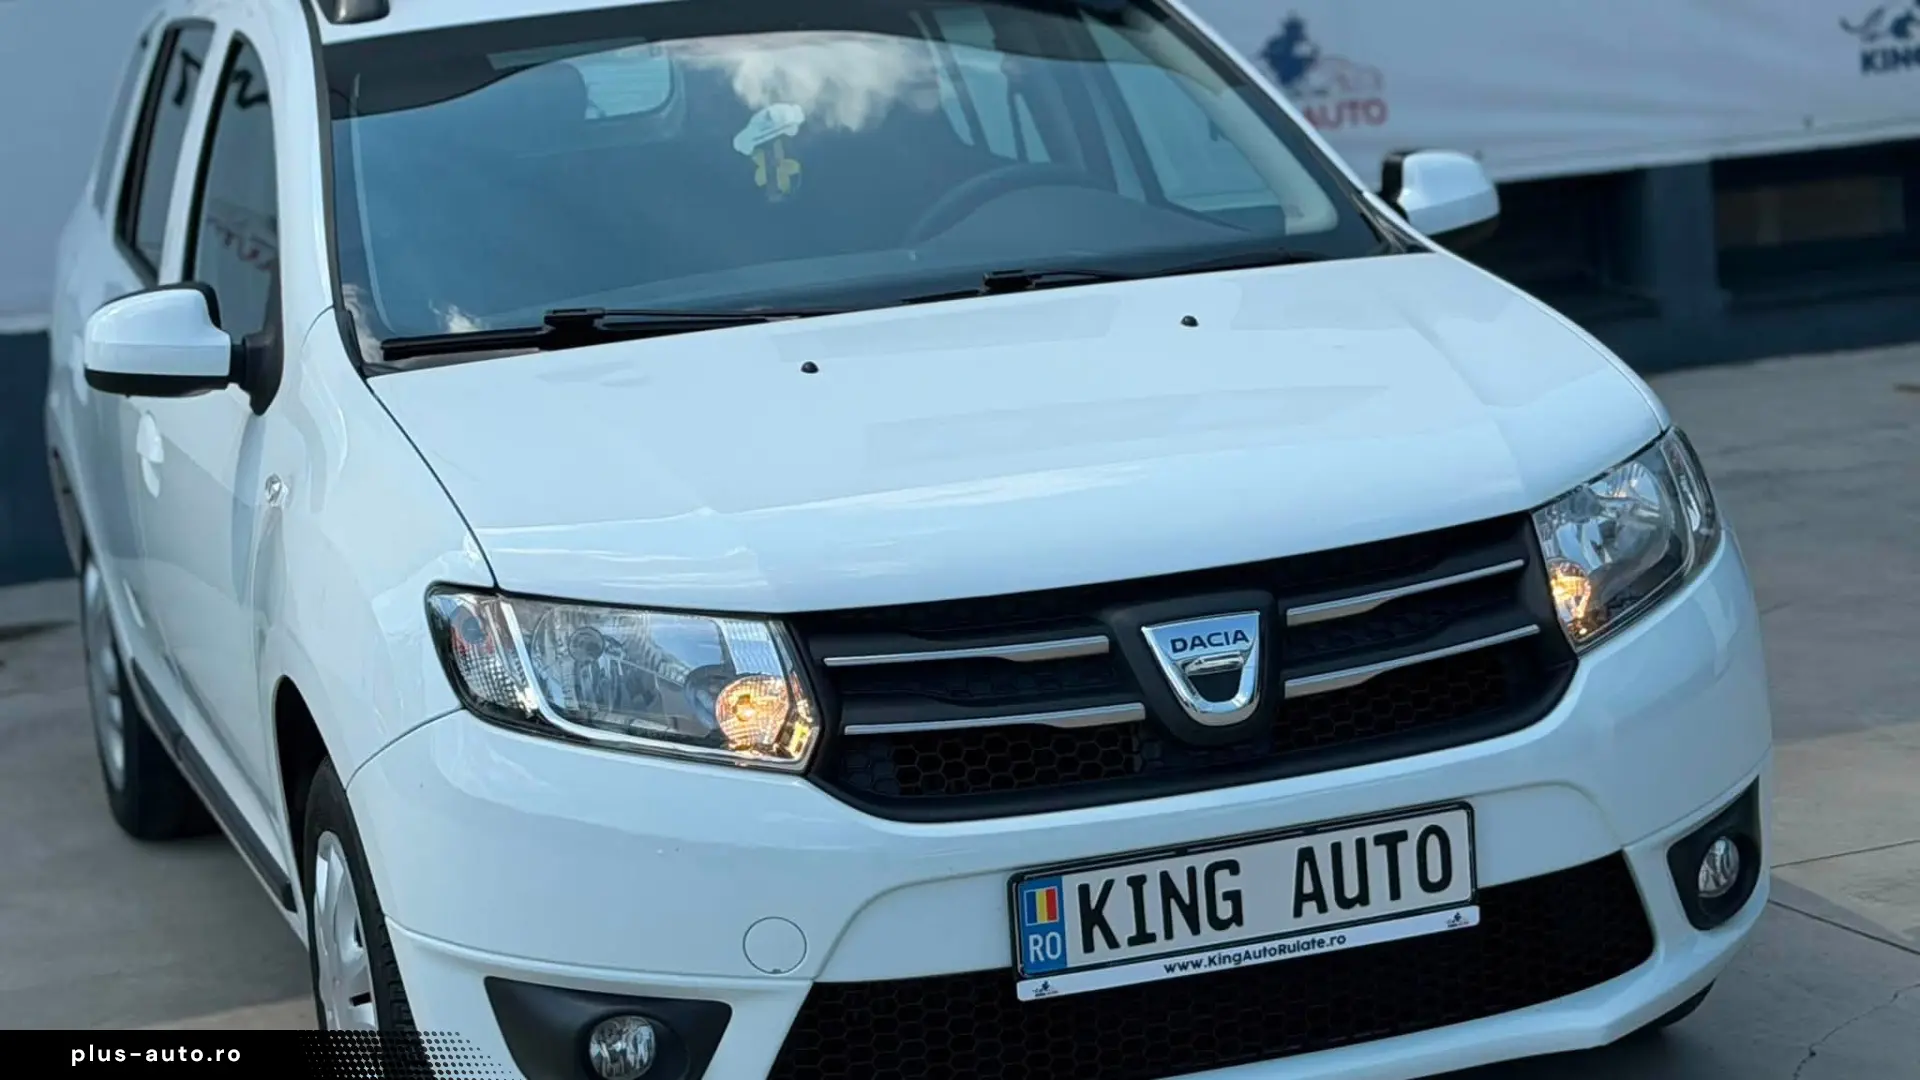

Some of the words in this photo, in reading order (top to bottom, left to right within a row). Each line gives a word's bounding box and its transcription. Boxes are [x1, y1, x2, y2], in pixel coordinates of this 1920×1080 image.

[1170, 629, 1249, 653] DACIA
[1077, 859, 1244, 953] KING
[1293, 824, 1453, 918] AUTO
[1029, 932, 1061, 963] RO
[1163, 934, 1347, 974] www.KingAutoRulate.ro
